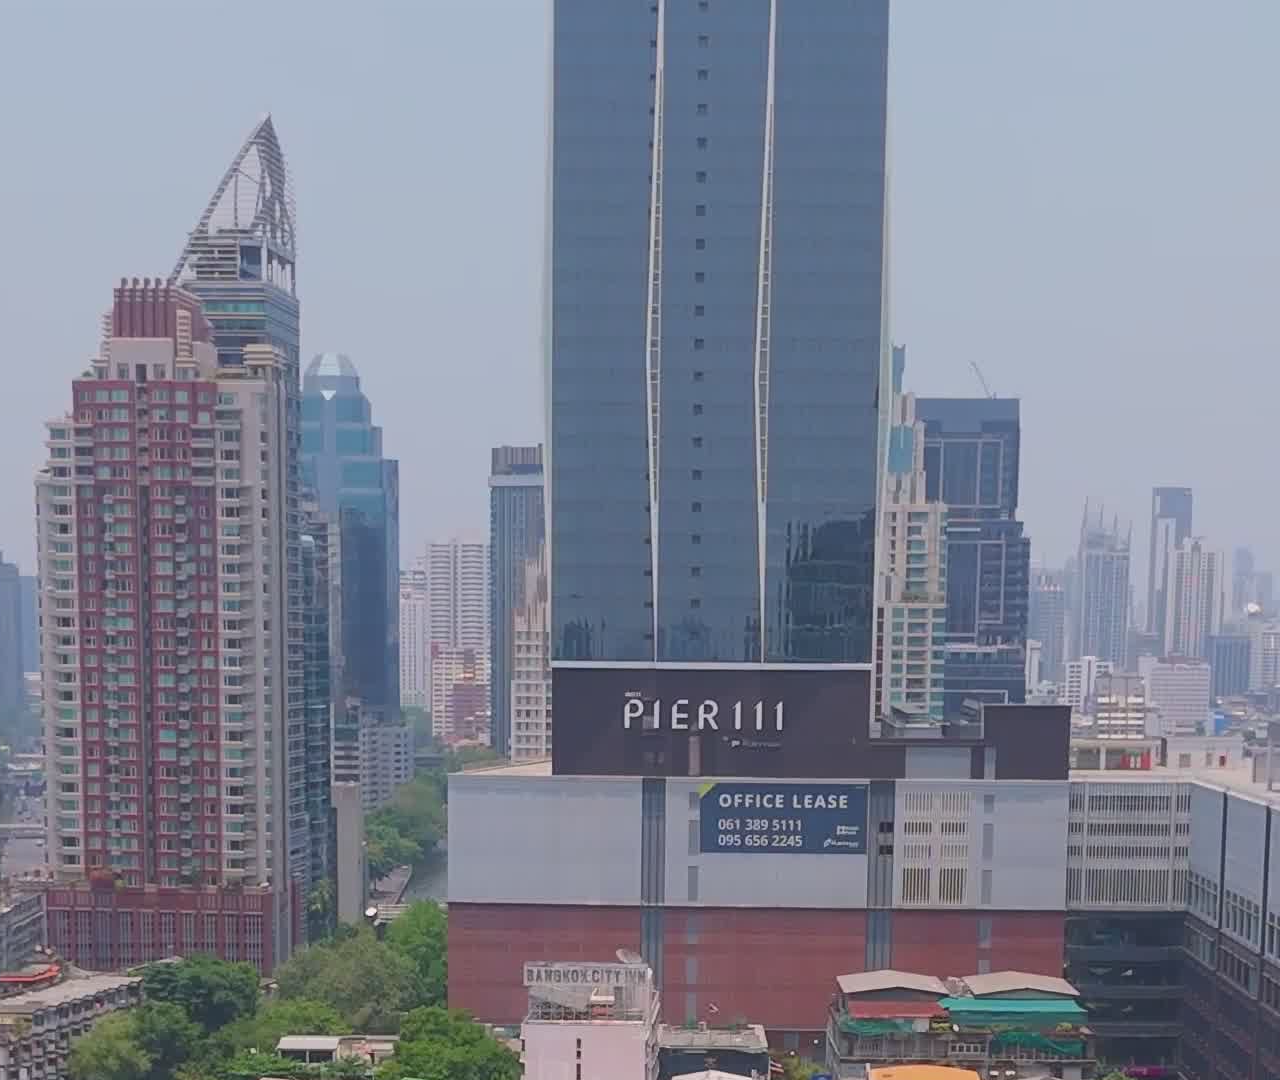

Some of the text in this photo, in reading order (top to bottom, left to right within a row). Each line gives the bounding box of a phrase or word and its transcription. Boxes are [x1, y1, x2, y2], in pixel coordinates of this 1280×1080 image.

[624, 698, 784, 731] PIER 111
[719, 793, 849, 809] OFFICE LEASE
[718, 818, 802, 831] 061 389 5111
[718, 834, 803, 847] 095 656 2245
[591, 969, 621, 983] CITY
